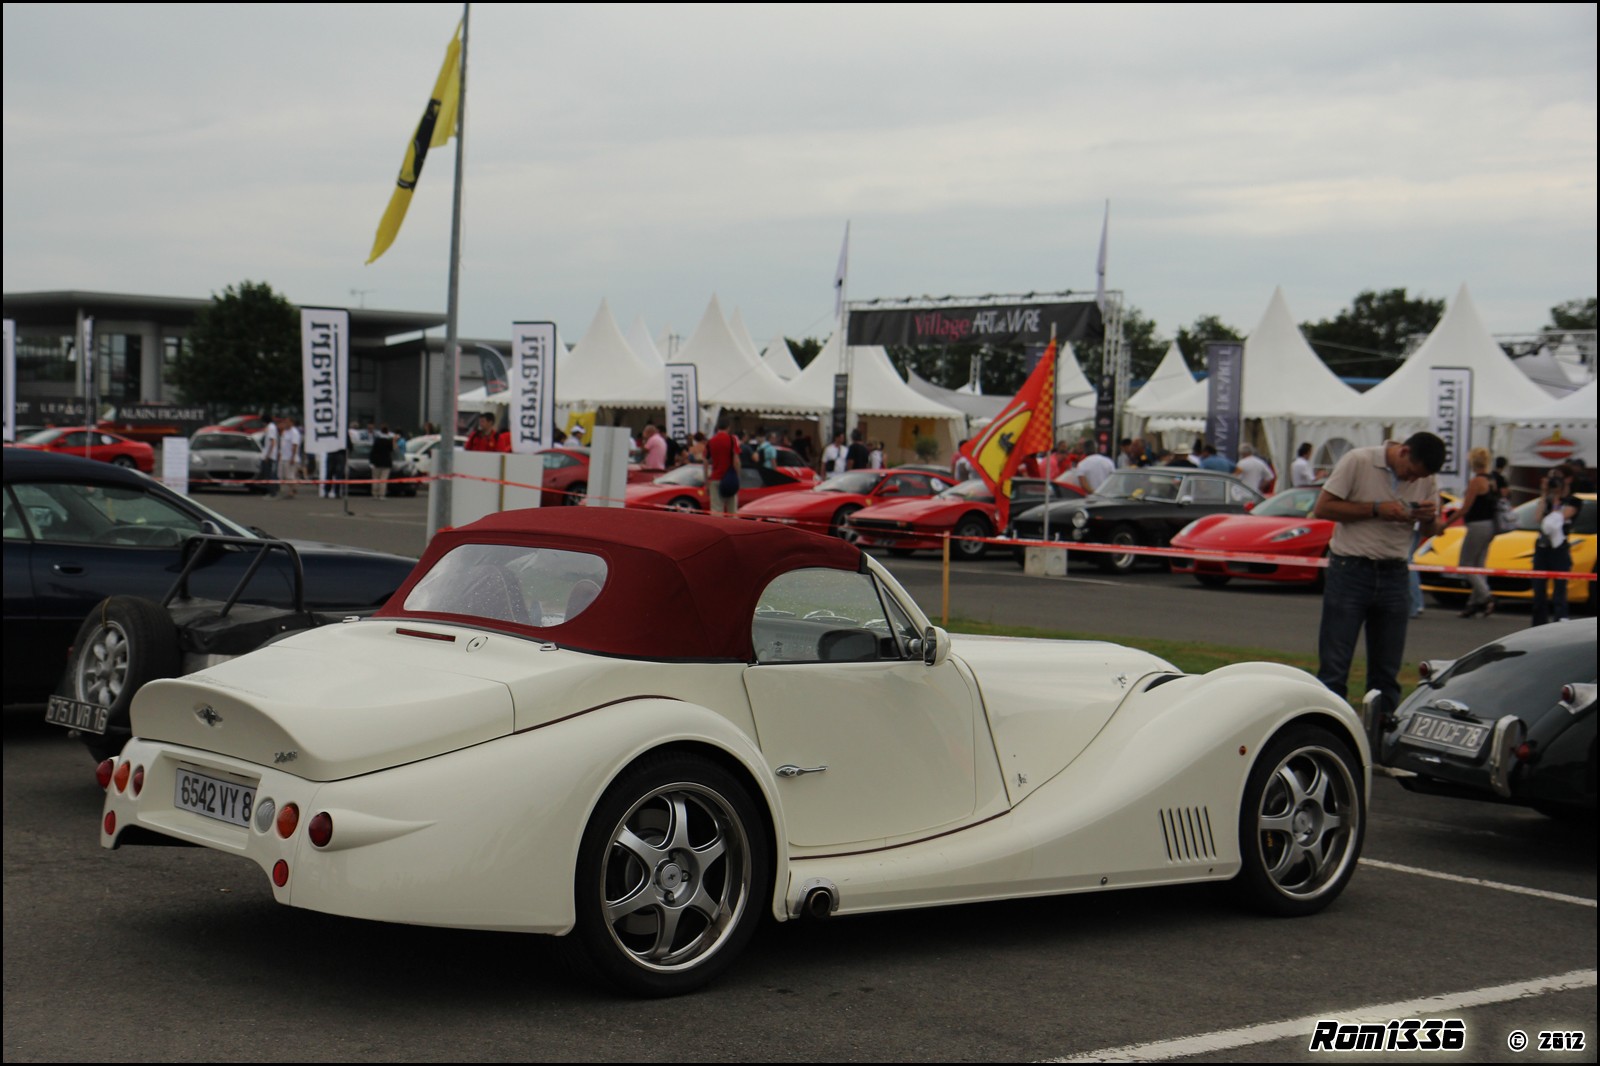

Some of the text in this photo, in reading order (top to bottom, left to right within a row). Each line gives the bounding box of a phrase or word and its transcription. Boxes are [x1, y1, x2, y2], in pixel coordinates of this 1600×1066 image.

[914, 312, 971, 341] Village
[972, 311, 997, 333] ART
[46, 698, 109, 732] 6751 VR 16
[181, 775, 255, 822] 6542 VY 8
